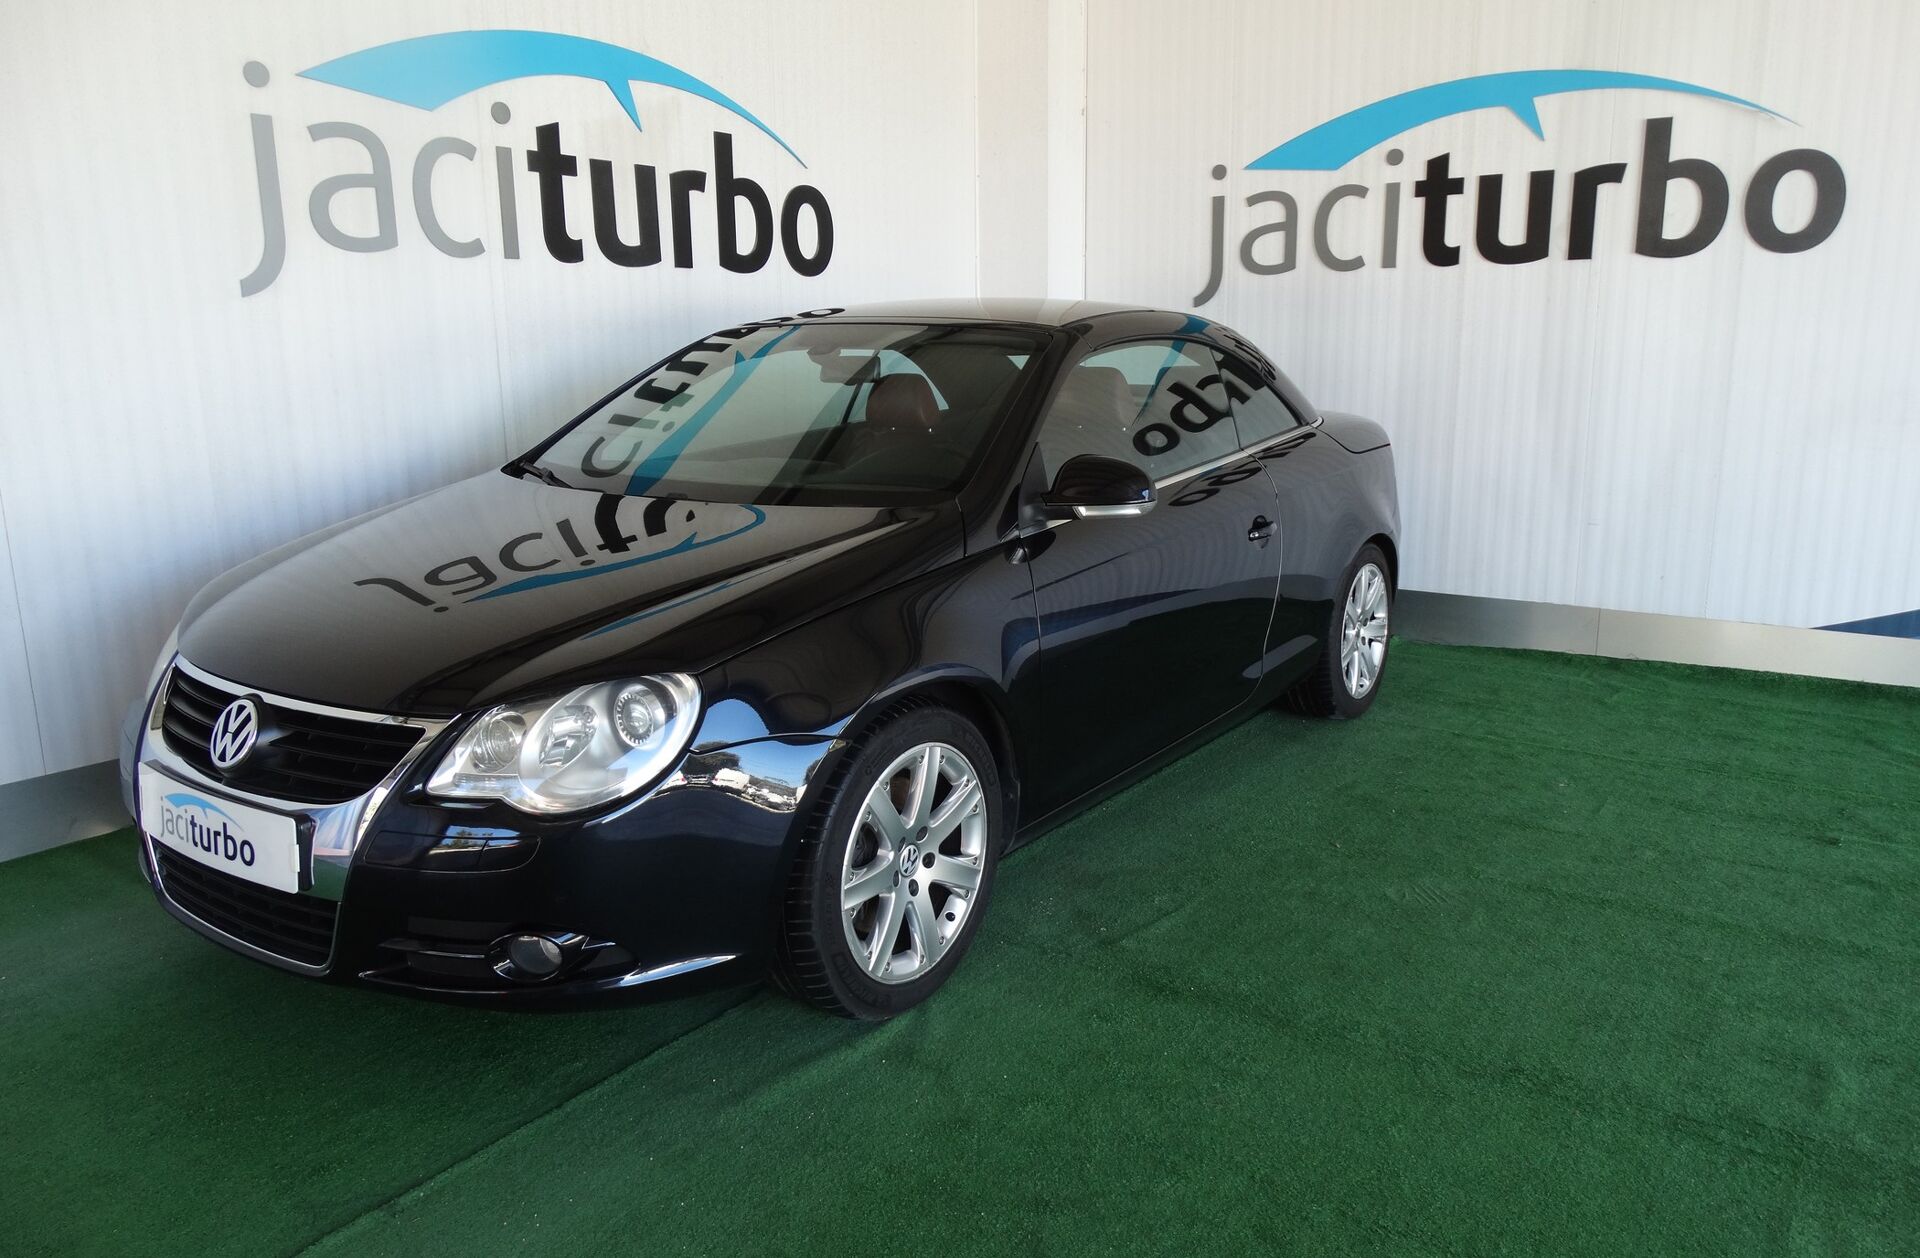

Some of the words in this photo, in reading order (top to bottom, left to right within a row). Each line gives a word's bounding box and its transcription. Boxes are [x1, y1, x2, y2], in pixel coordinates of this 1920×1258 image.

[239, 60, 835, 298] jaciturbo
[1192, 117, 1848, 308] jaciturbo
[211, 699, 258, 769] VW
[160, 796, 255, 867] jaciturbo
